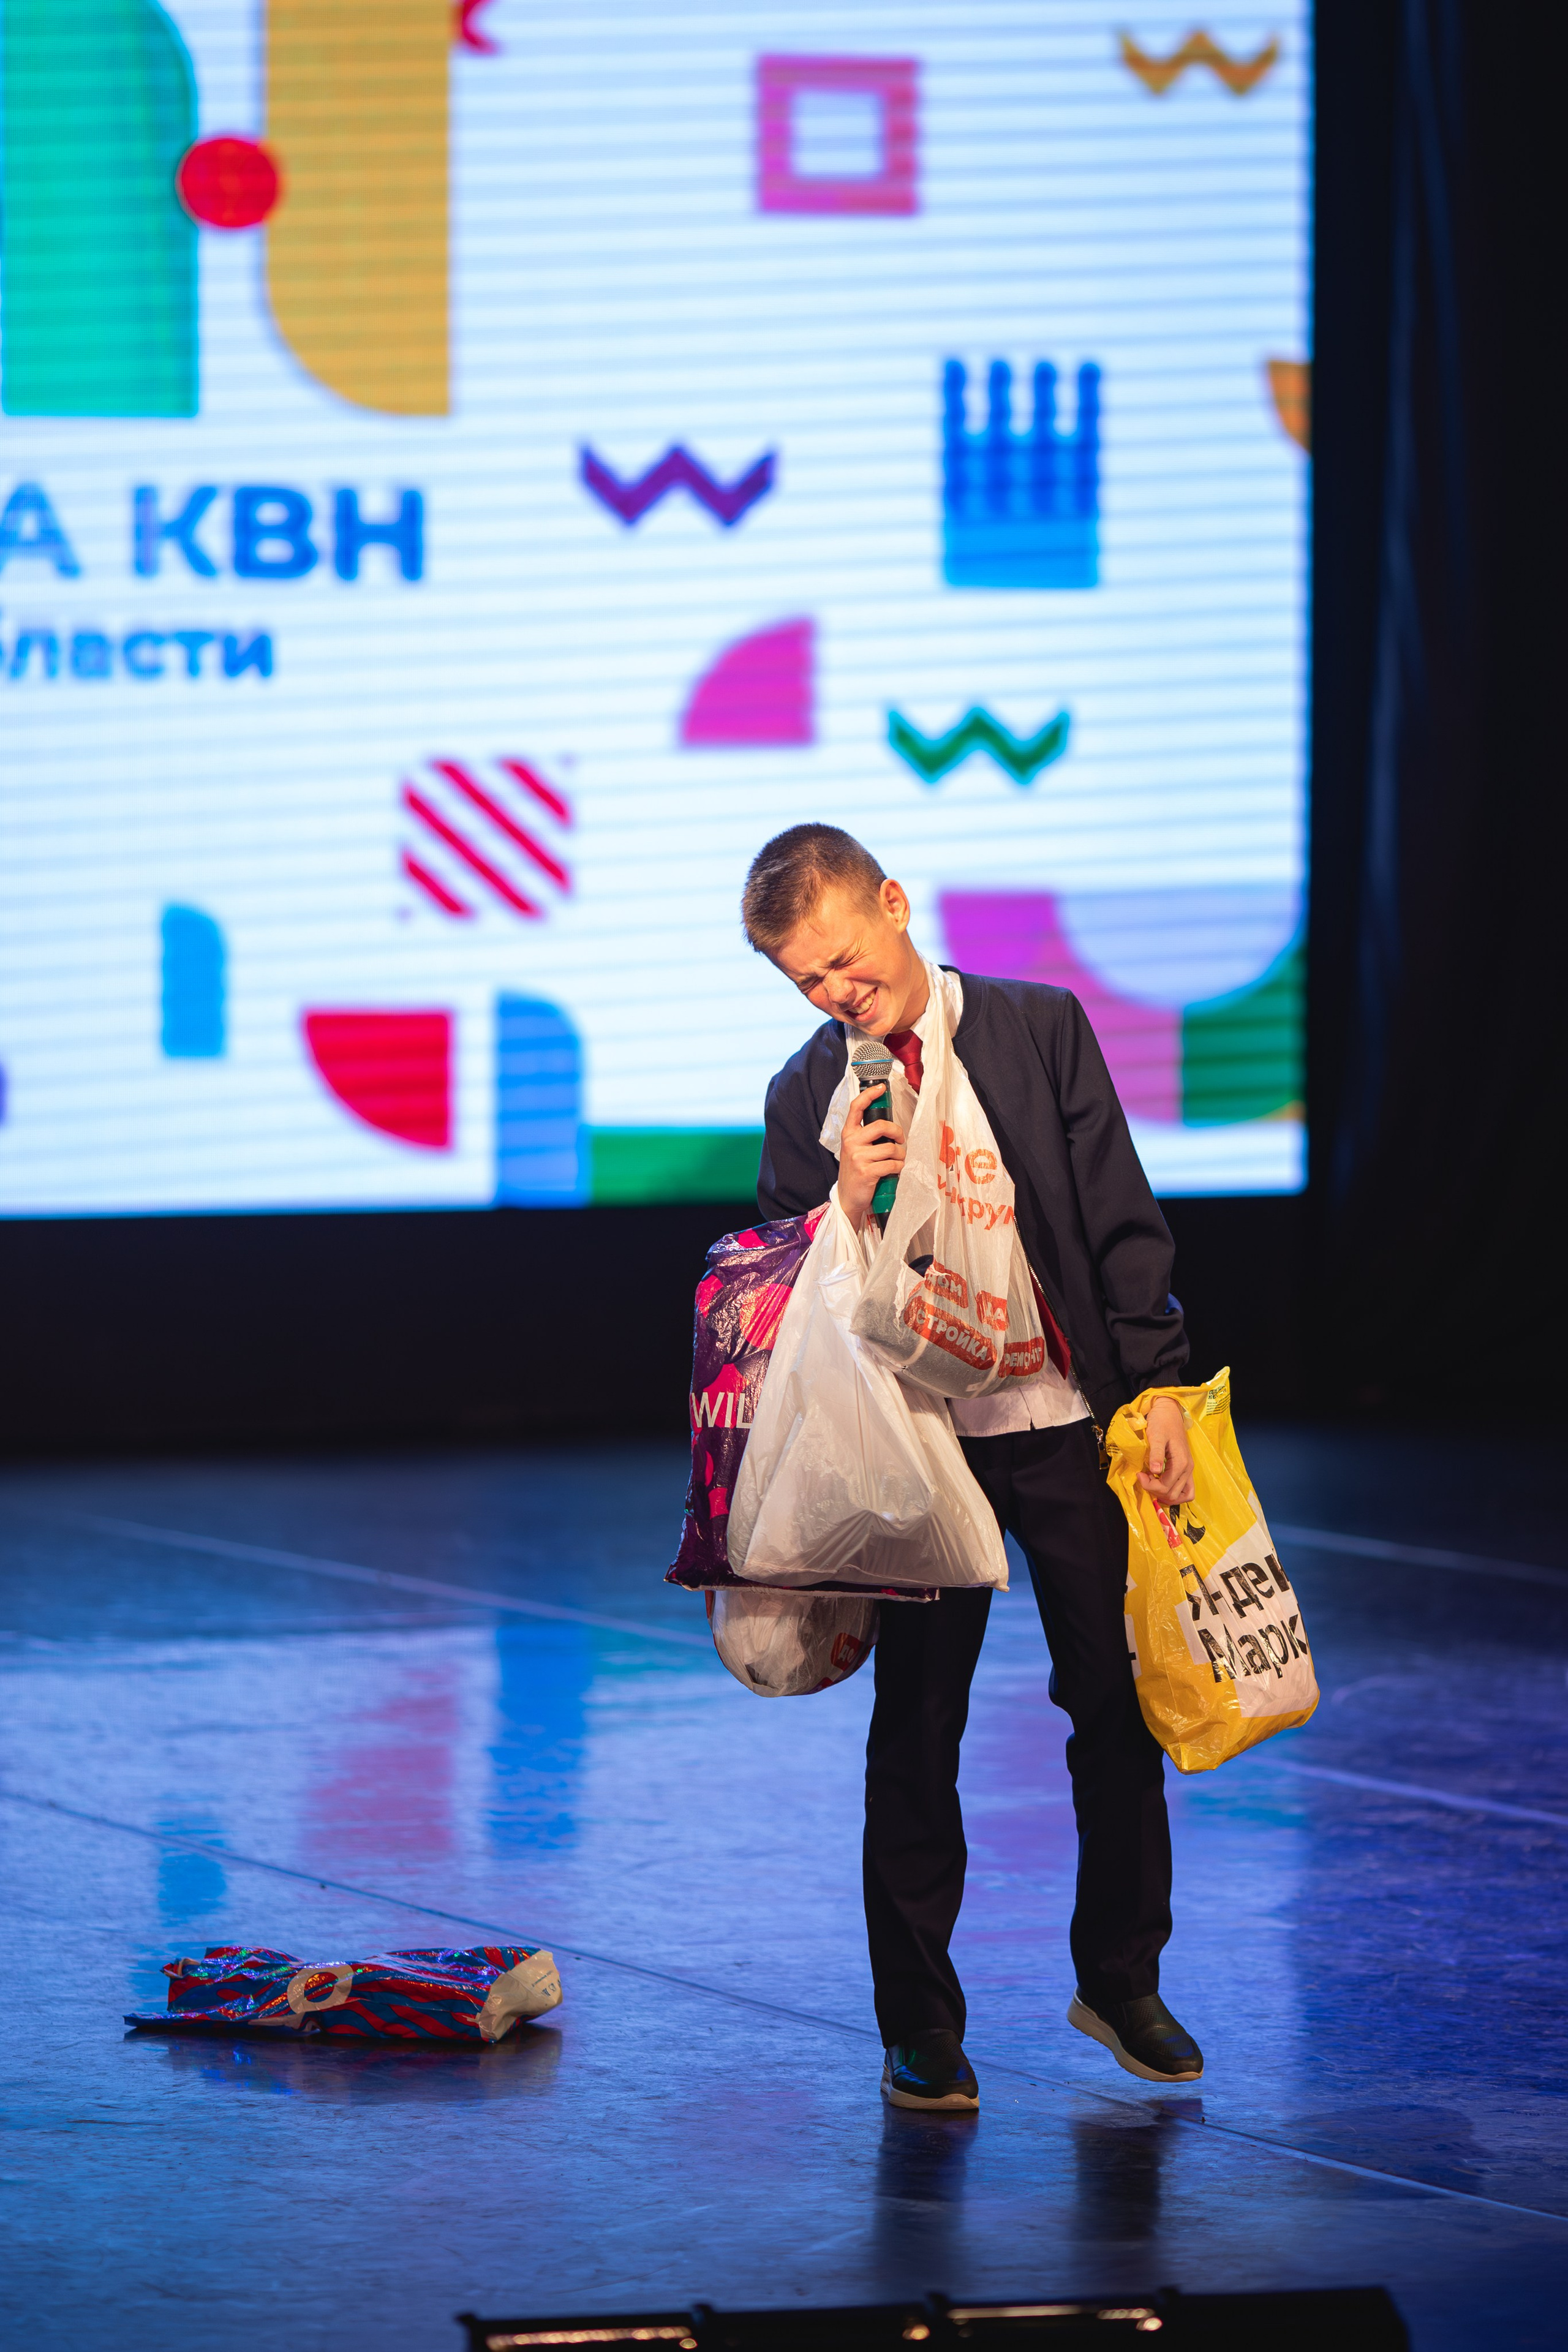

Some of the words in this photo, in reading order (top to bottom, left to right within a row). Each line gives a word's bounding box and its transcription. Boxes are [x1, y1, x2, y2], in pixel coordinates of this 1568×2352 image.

[132, 484, 424, 582] КВН
[0, 617, 273, 678] ласти
[916, 1308, 988, 1361] СТРОЙКА
[691, 1391, 753, 1428] WIL
[1197, 1613, 1308, 1683] Марк
